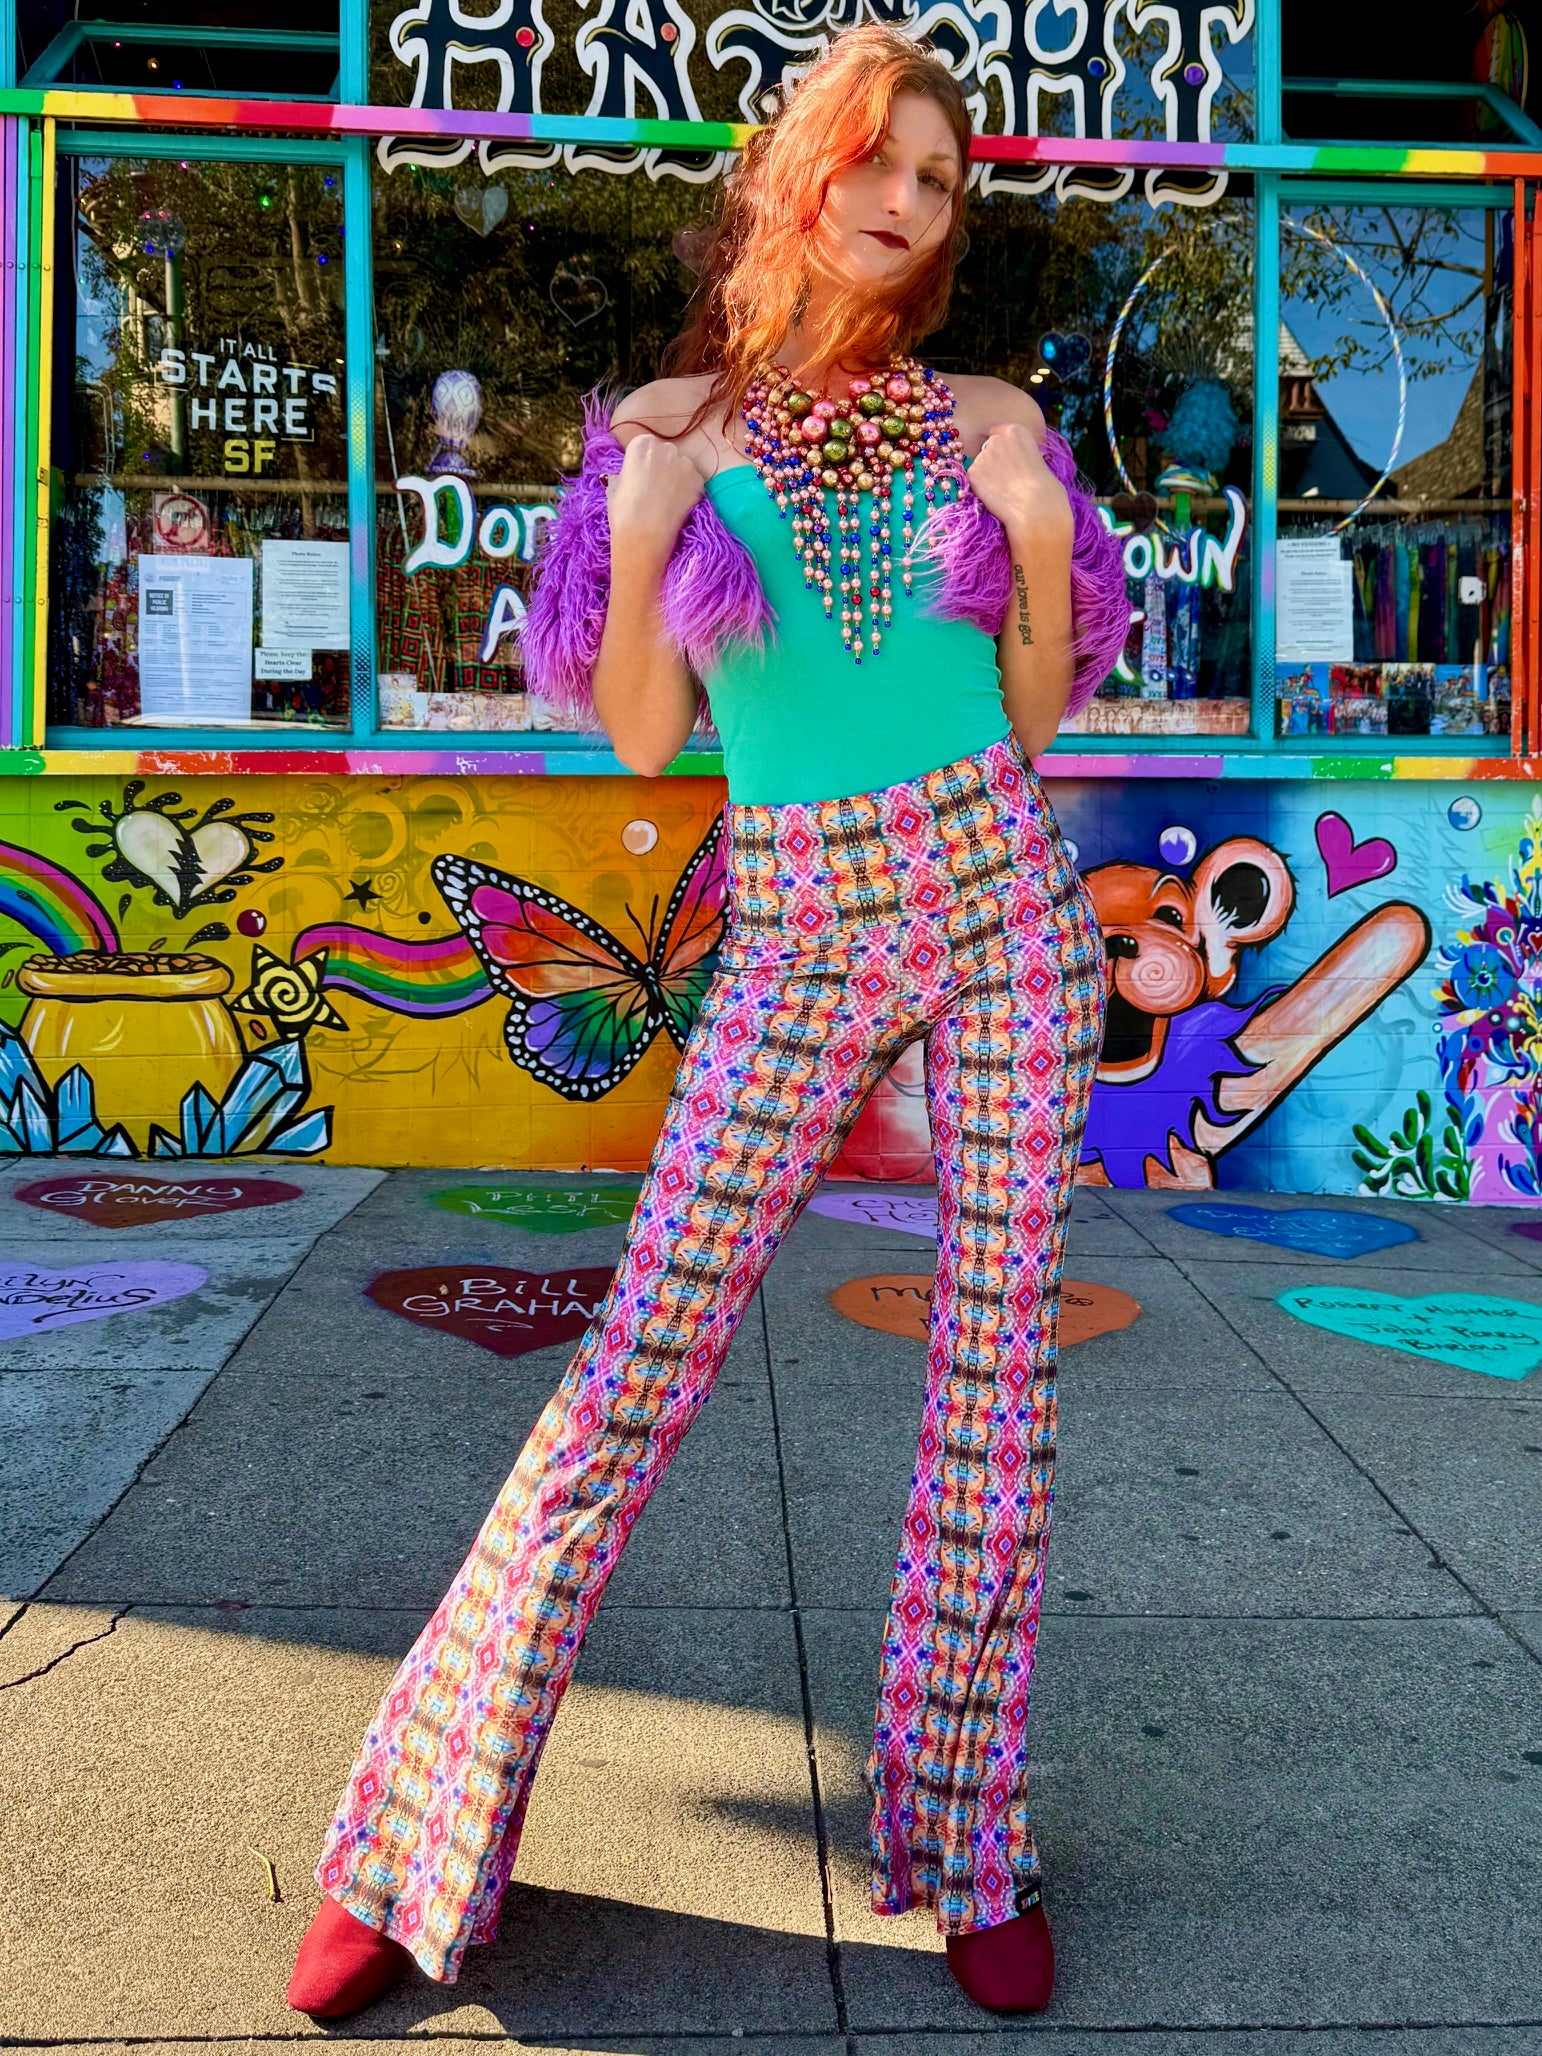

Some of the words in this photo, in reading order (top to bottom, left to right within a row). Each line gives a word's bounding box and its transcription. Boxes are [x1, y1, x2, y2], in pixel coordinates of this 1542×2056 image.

[220, 337, 237, 354] IT
[243, 343, 278, 361] ALL
[160, 348, 337, 395] STARTS
[191, 398, 308, 435] HERE
[224, 439, 276, 473] SF
[1014, 564, 1026, 585] our
[1016, 586, 1029, 609] love
[1019, 611, 1031, 622] is
[1018, 624, 1034, 645] god
